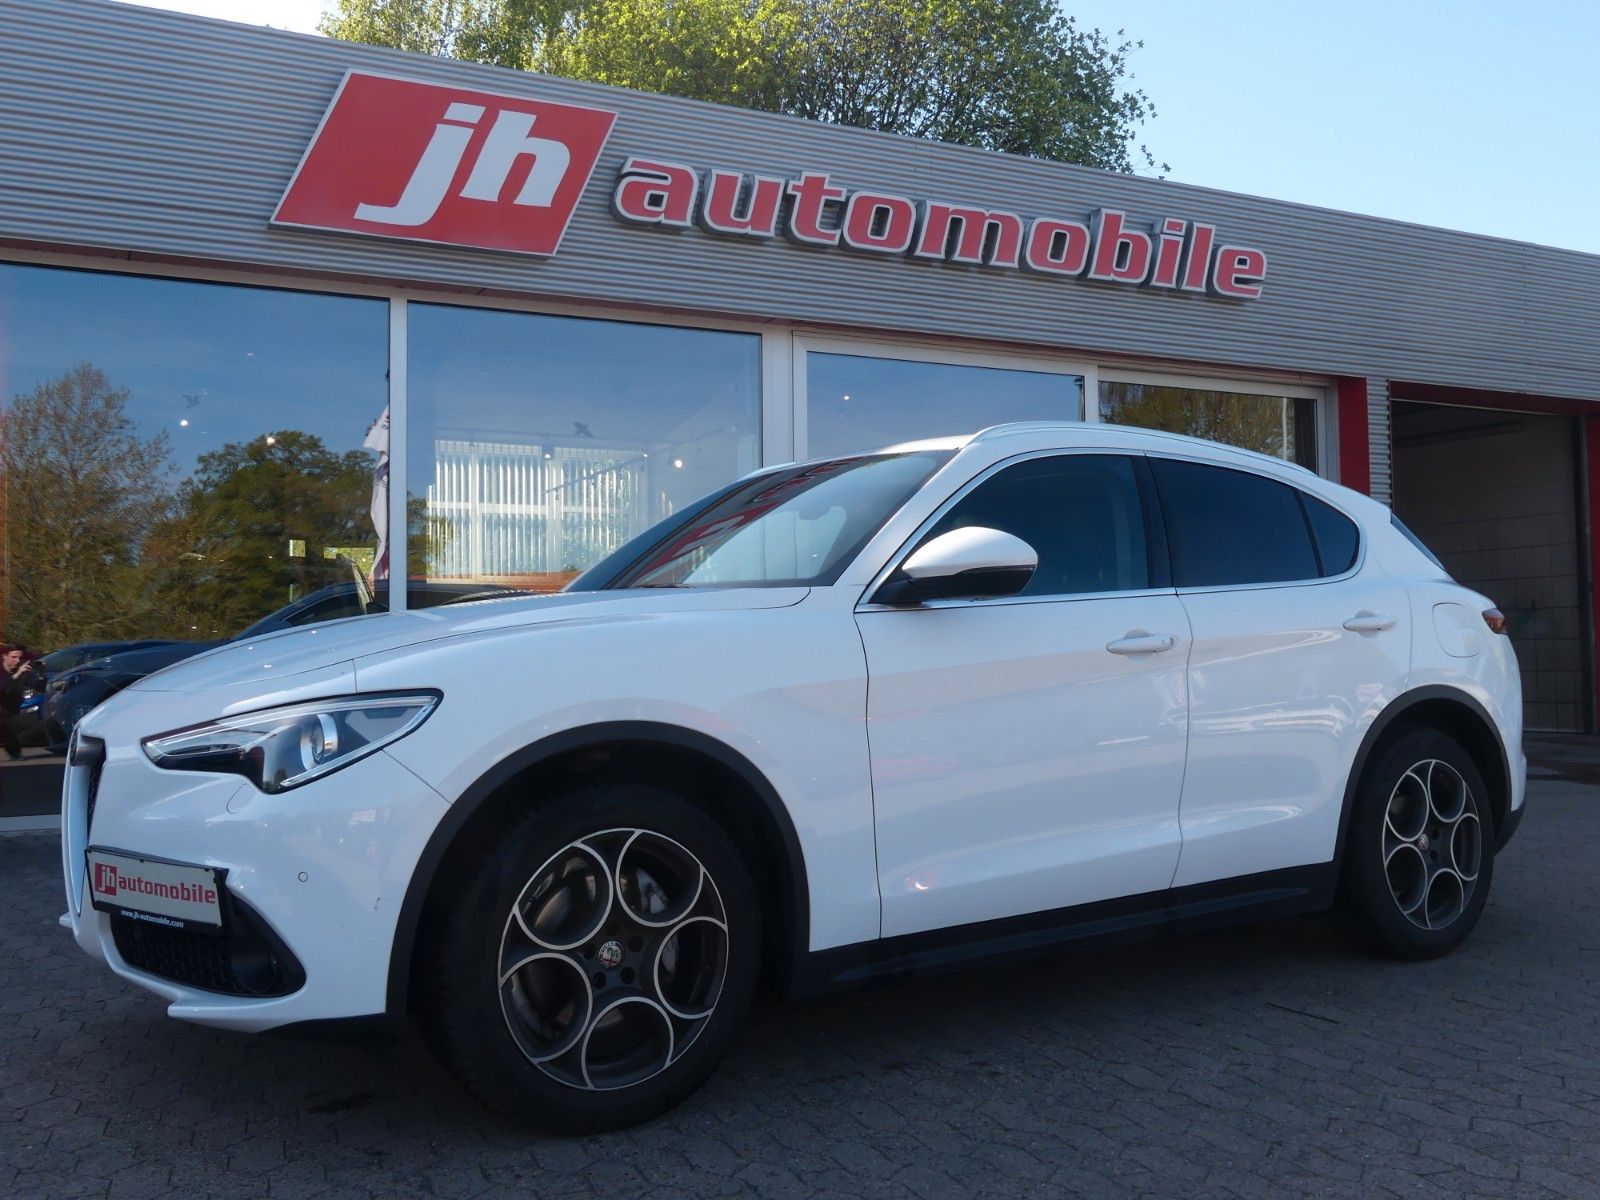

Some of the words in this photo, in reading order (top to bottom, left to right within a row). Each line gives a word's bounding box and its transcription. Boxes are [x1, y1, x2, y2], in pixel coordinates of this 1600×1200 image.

[353, 102, 571, 227] jh
[613, 156, 1268, 299] automobile
[118, 875, 216, 904] automobile
